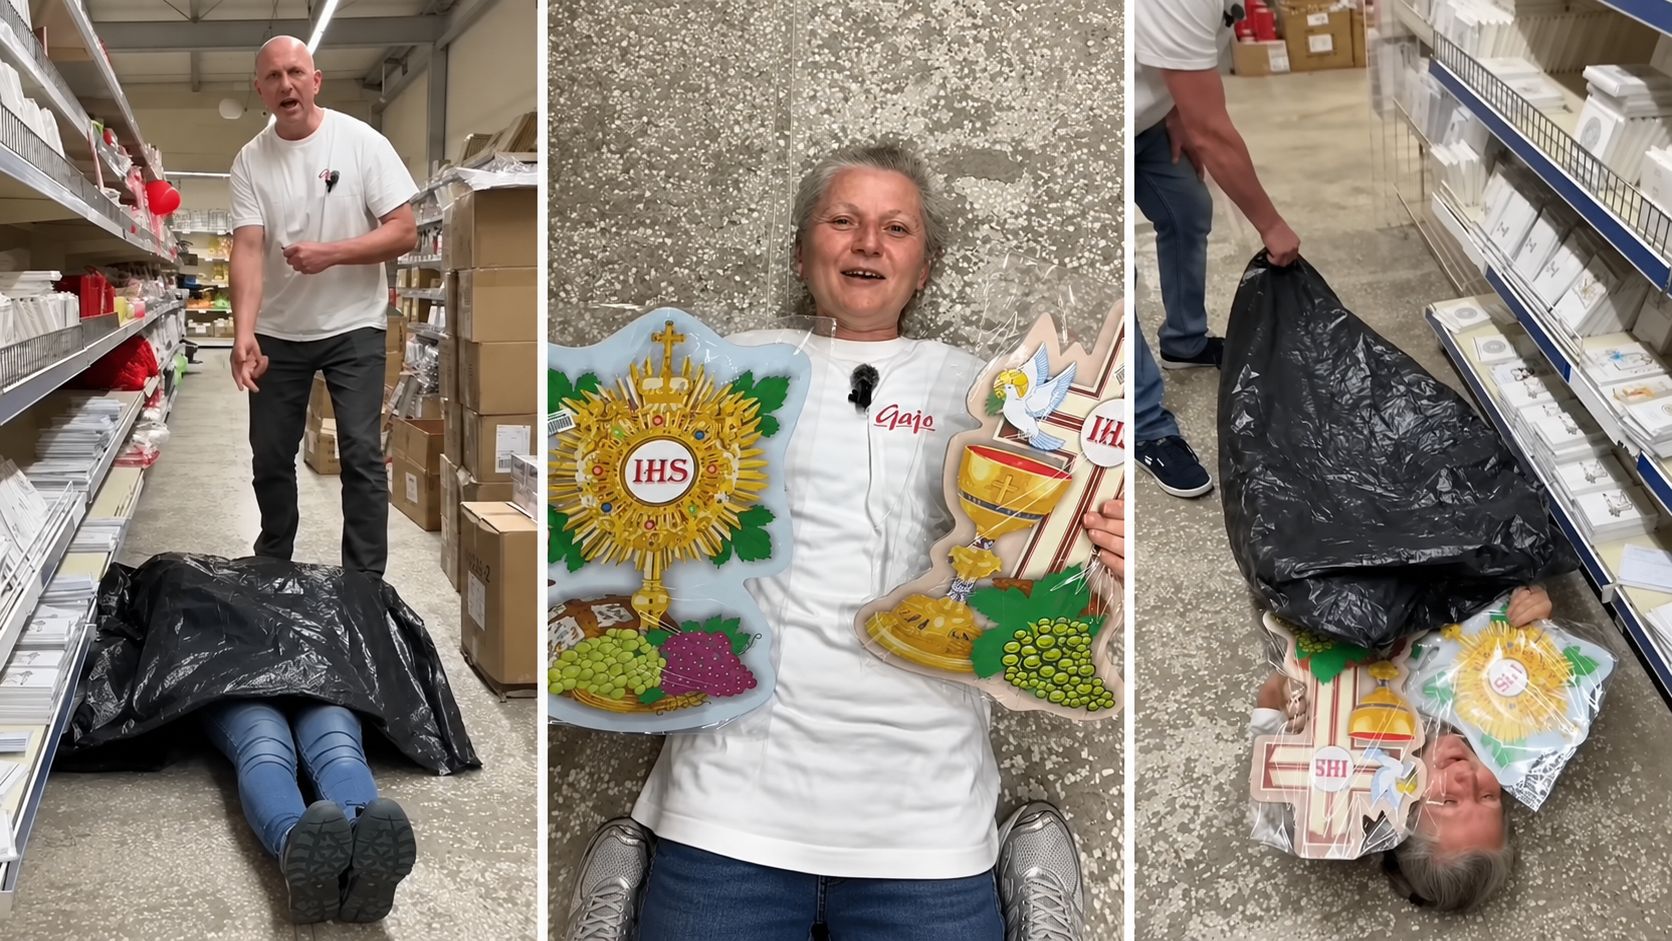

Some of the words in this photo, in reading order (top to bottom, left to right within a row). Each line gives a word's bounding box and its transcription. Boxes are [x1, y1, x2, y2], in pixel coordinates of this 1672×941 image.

[874, 404, 935, 434] Gajo
[1086, 415, 1124, 449] IH
[632, 458, 688, 484] IHS
